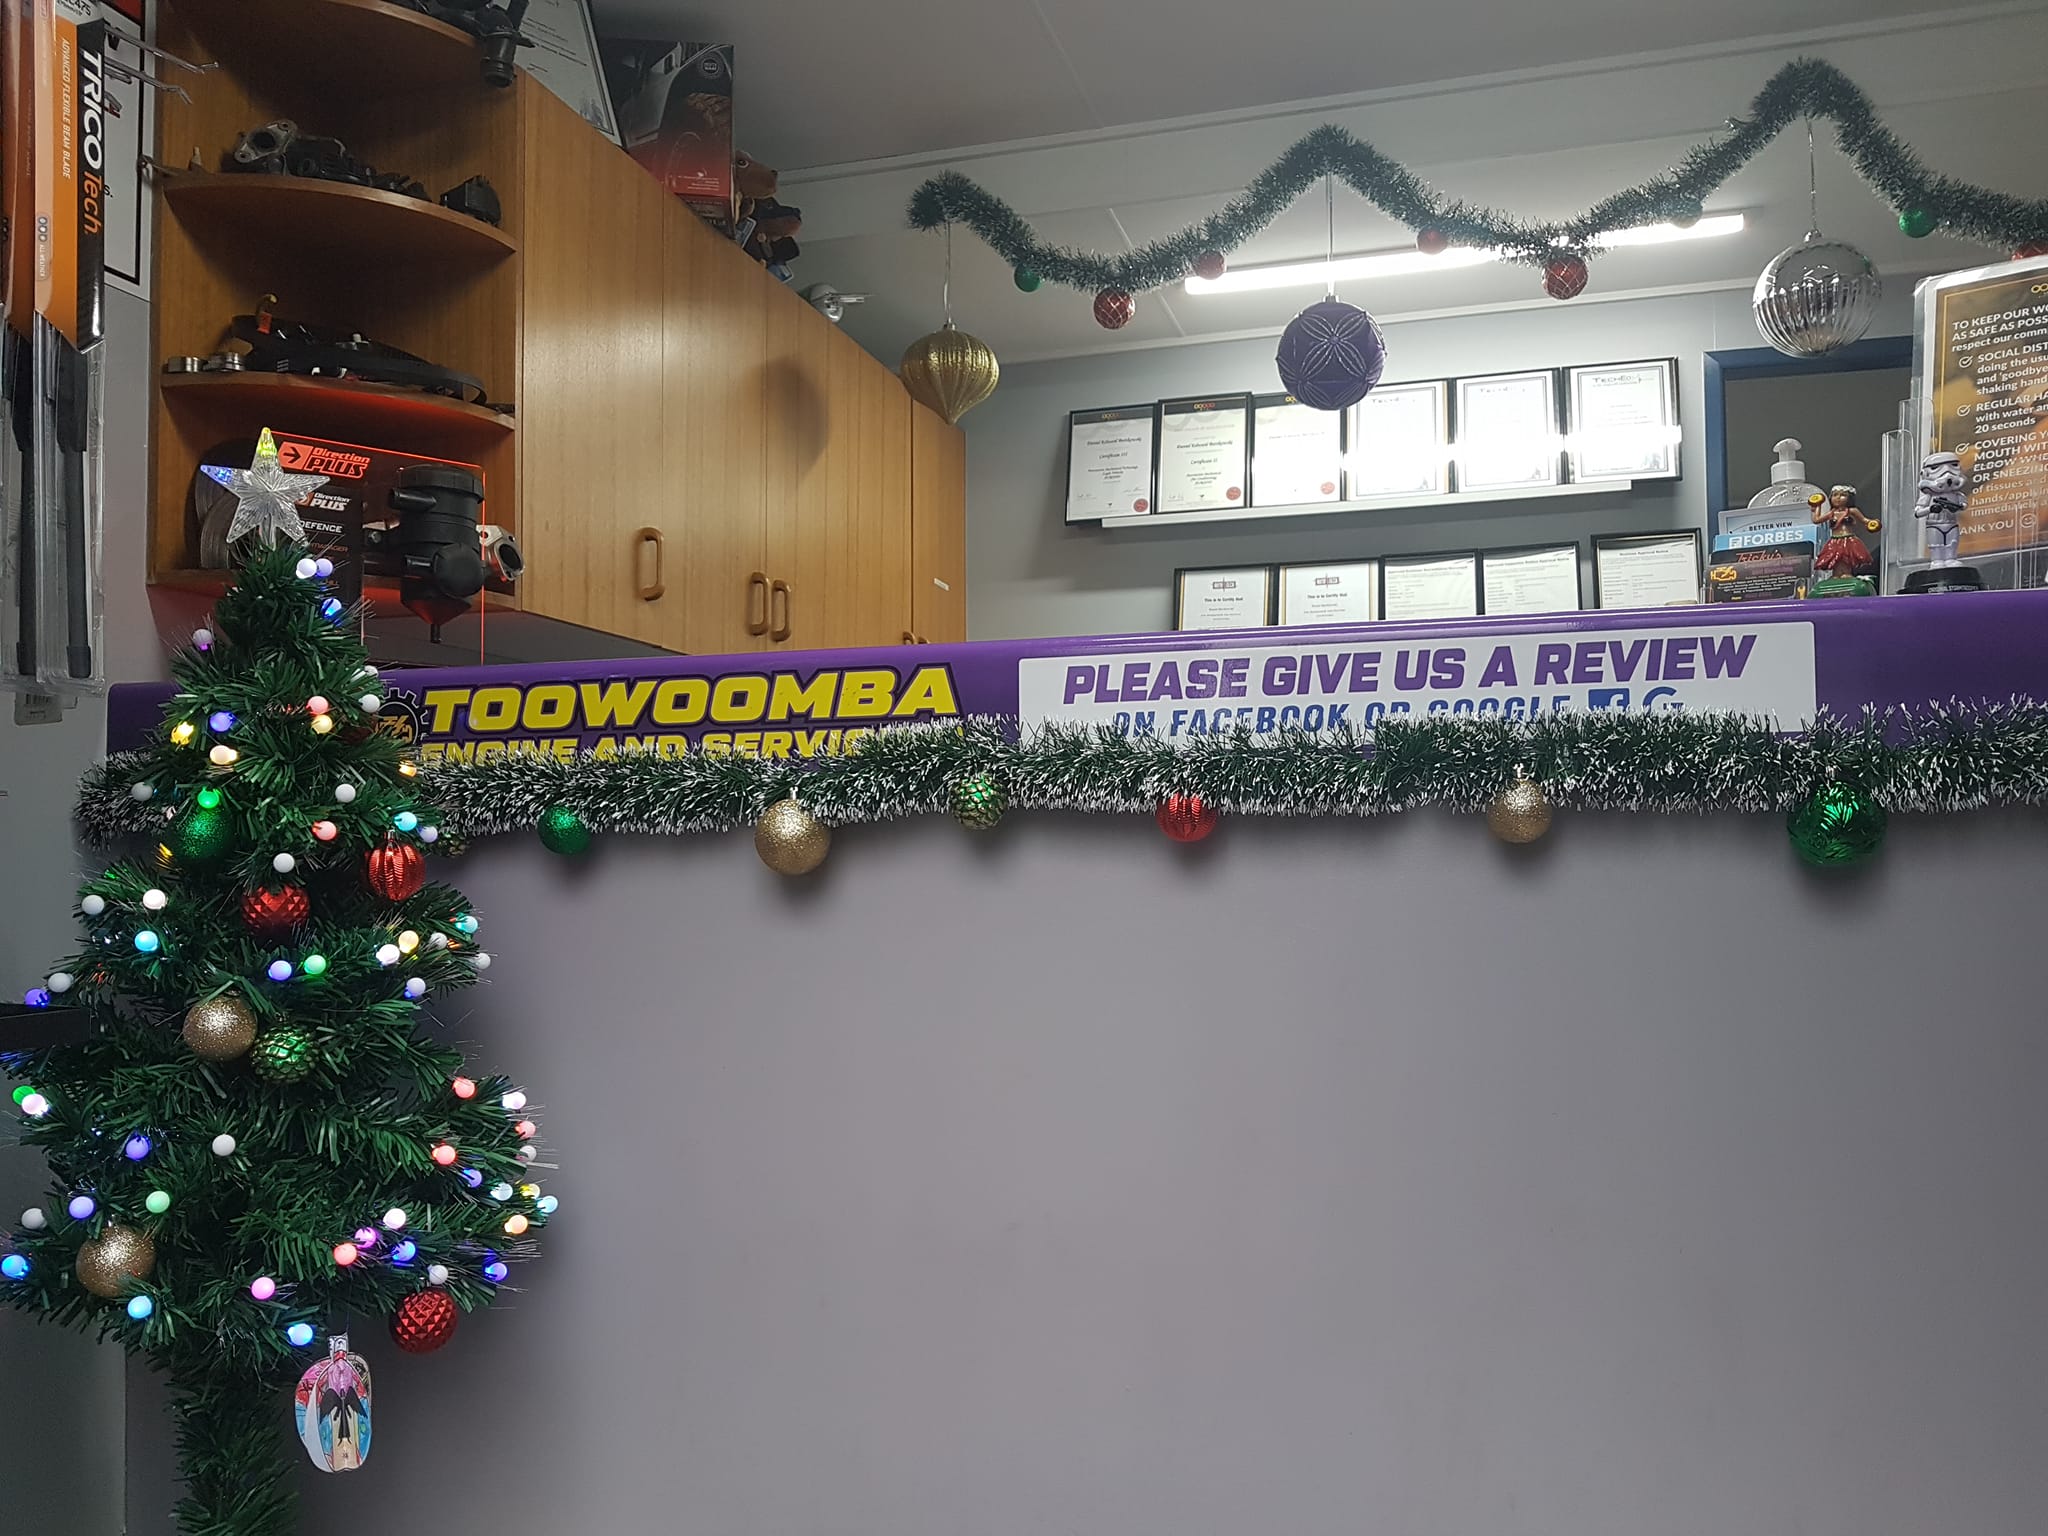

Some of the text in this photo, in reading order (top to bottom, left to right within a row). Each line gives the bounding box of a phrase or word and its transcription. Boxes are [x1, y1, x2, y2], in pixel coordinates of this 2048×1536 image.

[62, 38, 71, 179] ADVANCED FLEXIBLE BEAM BLADE
[83, 50, 103, 170] TRICO
[1952, 320, 1969, 330] TO
[1972, 313, 2000, 327] KEEP
[2003, 308, 2030, 320] OUR
[1952, 332, 1967, 342] AS
[1969, 325, 1998, 338] SAFE
[2000, 321, 2015, 332] AS
[1952, 337, 1990, 352] respect
[1994, 334, 2011, 344] our
[1978, 342, 2048, 363] SOCIAL DIST
[1977, 361, 2008, 374] doing
[2010, 356, 2028, 367] the
[1976, 375, 2047, 396] shaking hand
[1977, 373, 1997, 385] and
[1976, 395, 2030, 412] REGULAR
[1975, 411, 2000, 423] with
[2002, 406, 2033, 418] water
[1974, 417, 2036, 434] 20 seconds
[1974, 432, 2037, 450] COVERING
[312, 447, 370, 463] Direction
[1974, 447, 2020, 461] MOUTH
[304, 454, 370, 479] PLUS
[1973, 458, 2016, 472] ELBOW
[1972, 472, 1990, 483] OR
[1972, 476, 2046, 494] of tissues ad
[310, 498, 347, 511] PLUS
[314, 492, 352, 503] Direction
[1971, 500, 2038, 517] immediately
[1748, 522, 1774, 531] BETTER
[1959, 519, 2014, 535] ANK YOU
[1743, 530, 1804, 546] FORBES
[1064, 635, 1757, 704] PLEASE GIVE US A REVIEW
[425, 667, 957, 733] TOOWOOMBA
[1115, 711, 1156, 738] ON
[1170, 704, 1350, 737] FACEBOOK
[590, 734, 688, 762] AND
